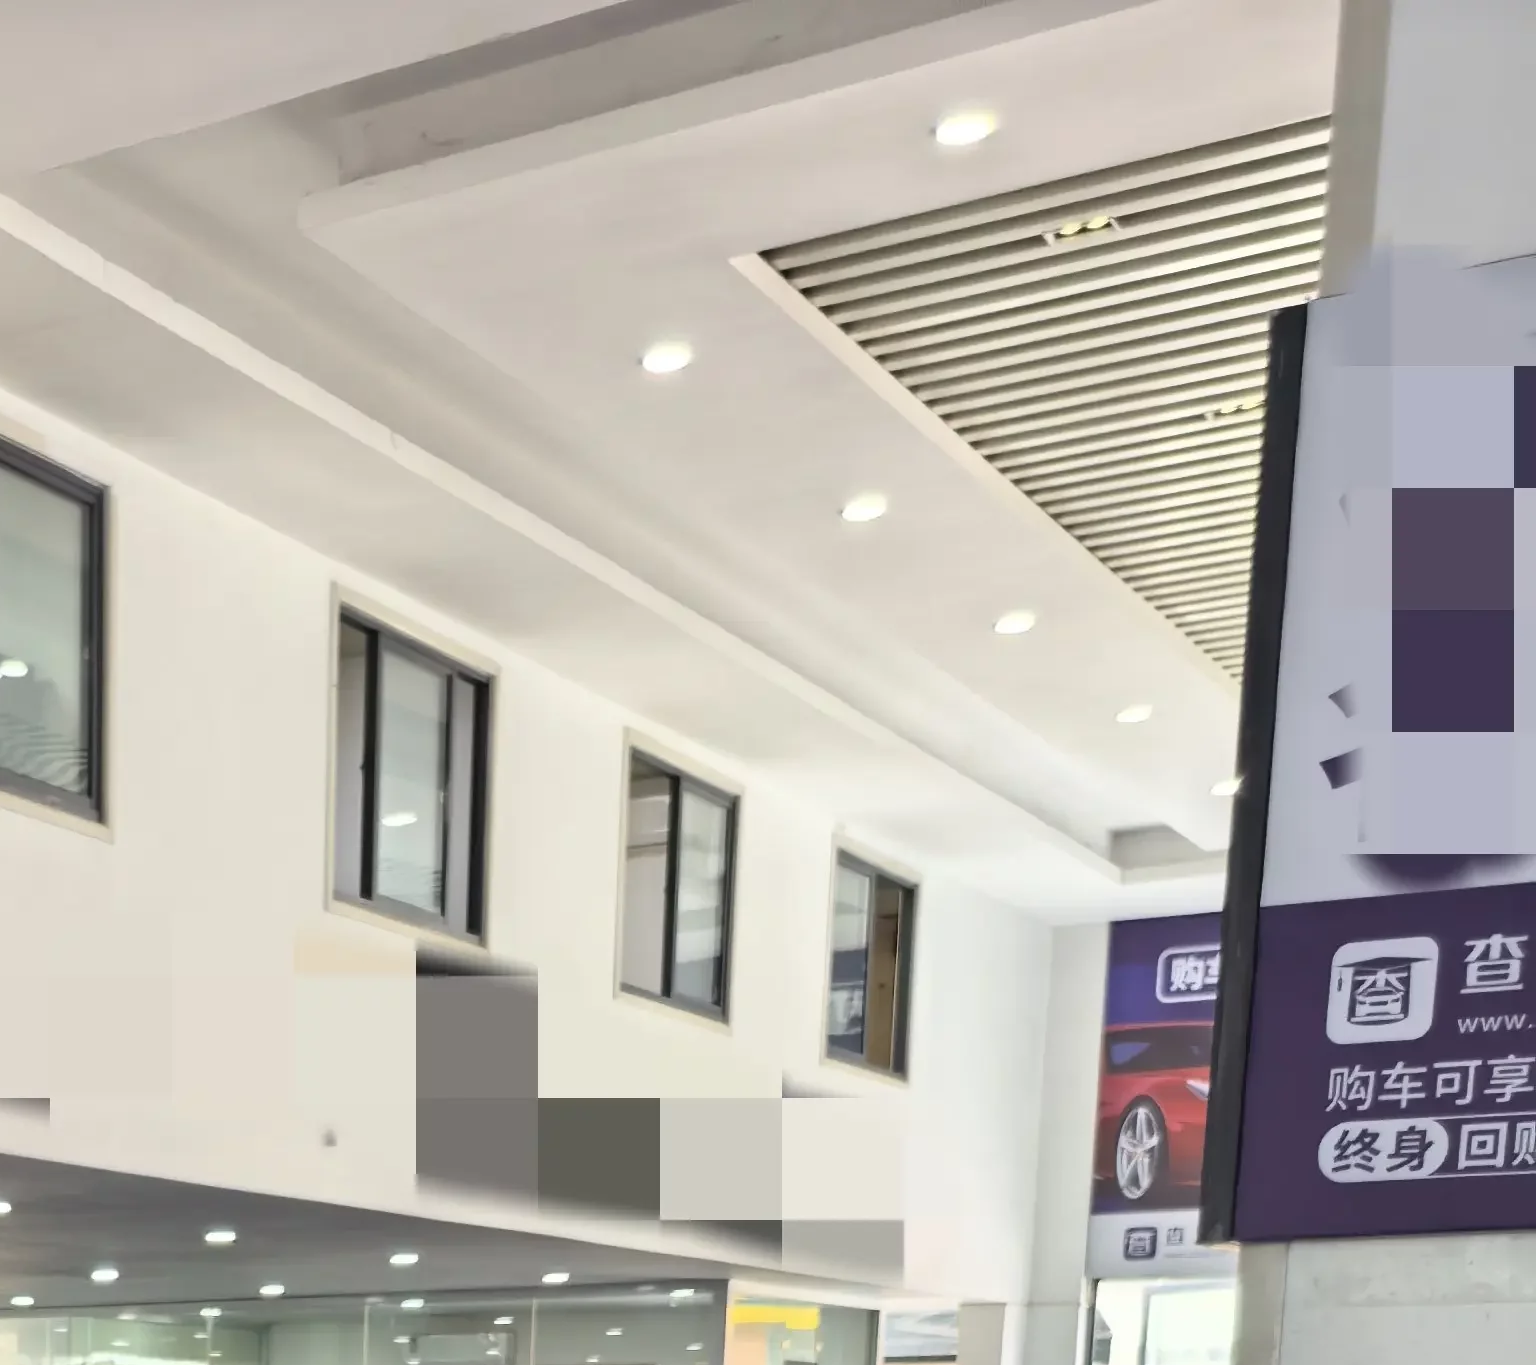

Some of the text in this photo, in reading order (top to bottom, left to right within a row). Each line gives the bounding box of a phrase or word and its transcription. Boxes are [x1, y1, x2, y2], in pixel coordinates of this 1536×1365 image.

[1460, 934, 1529, 994] 查
[1325, 1054, 1536, 1112] 购车可享
